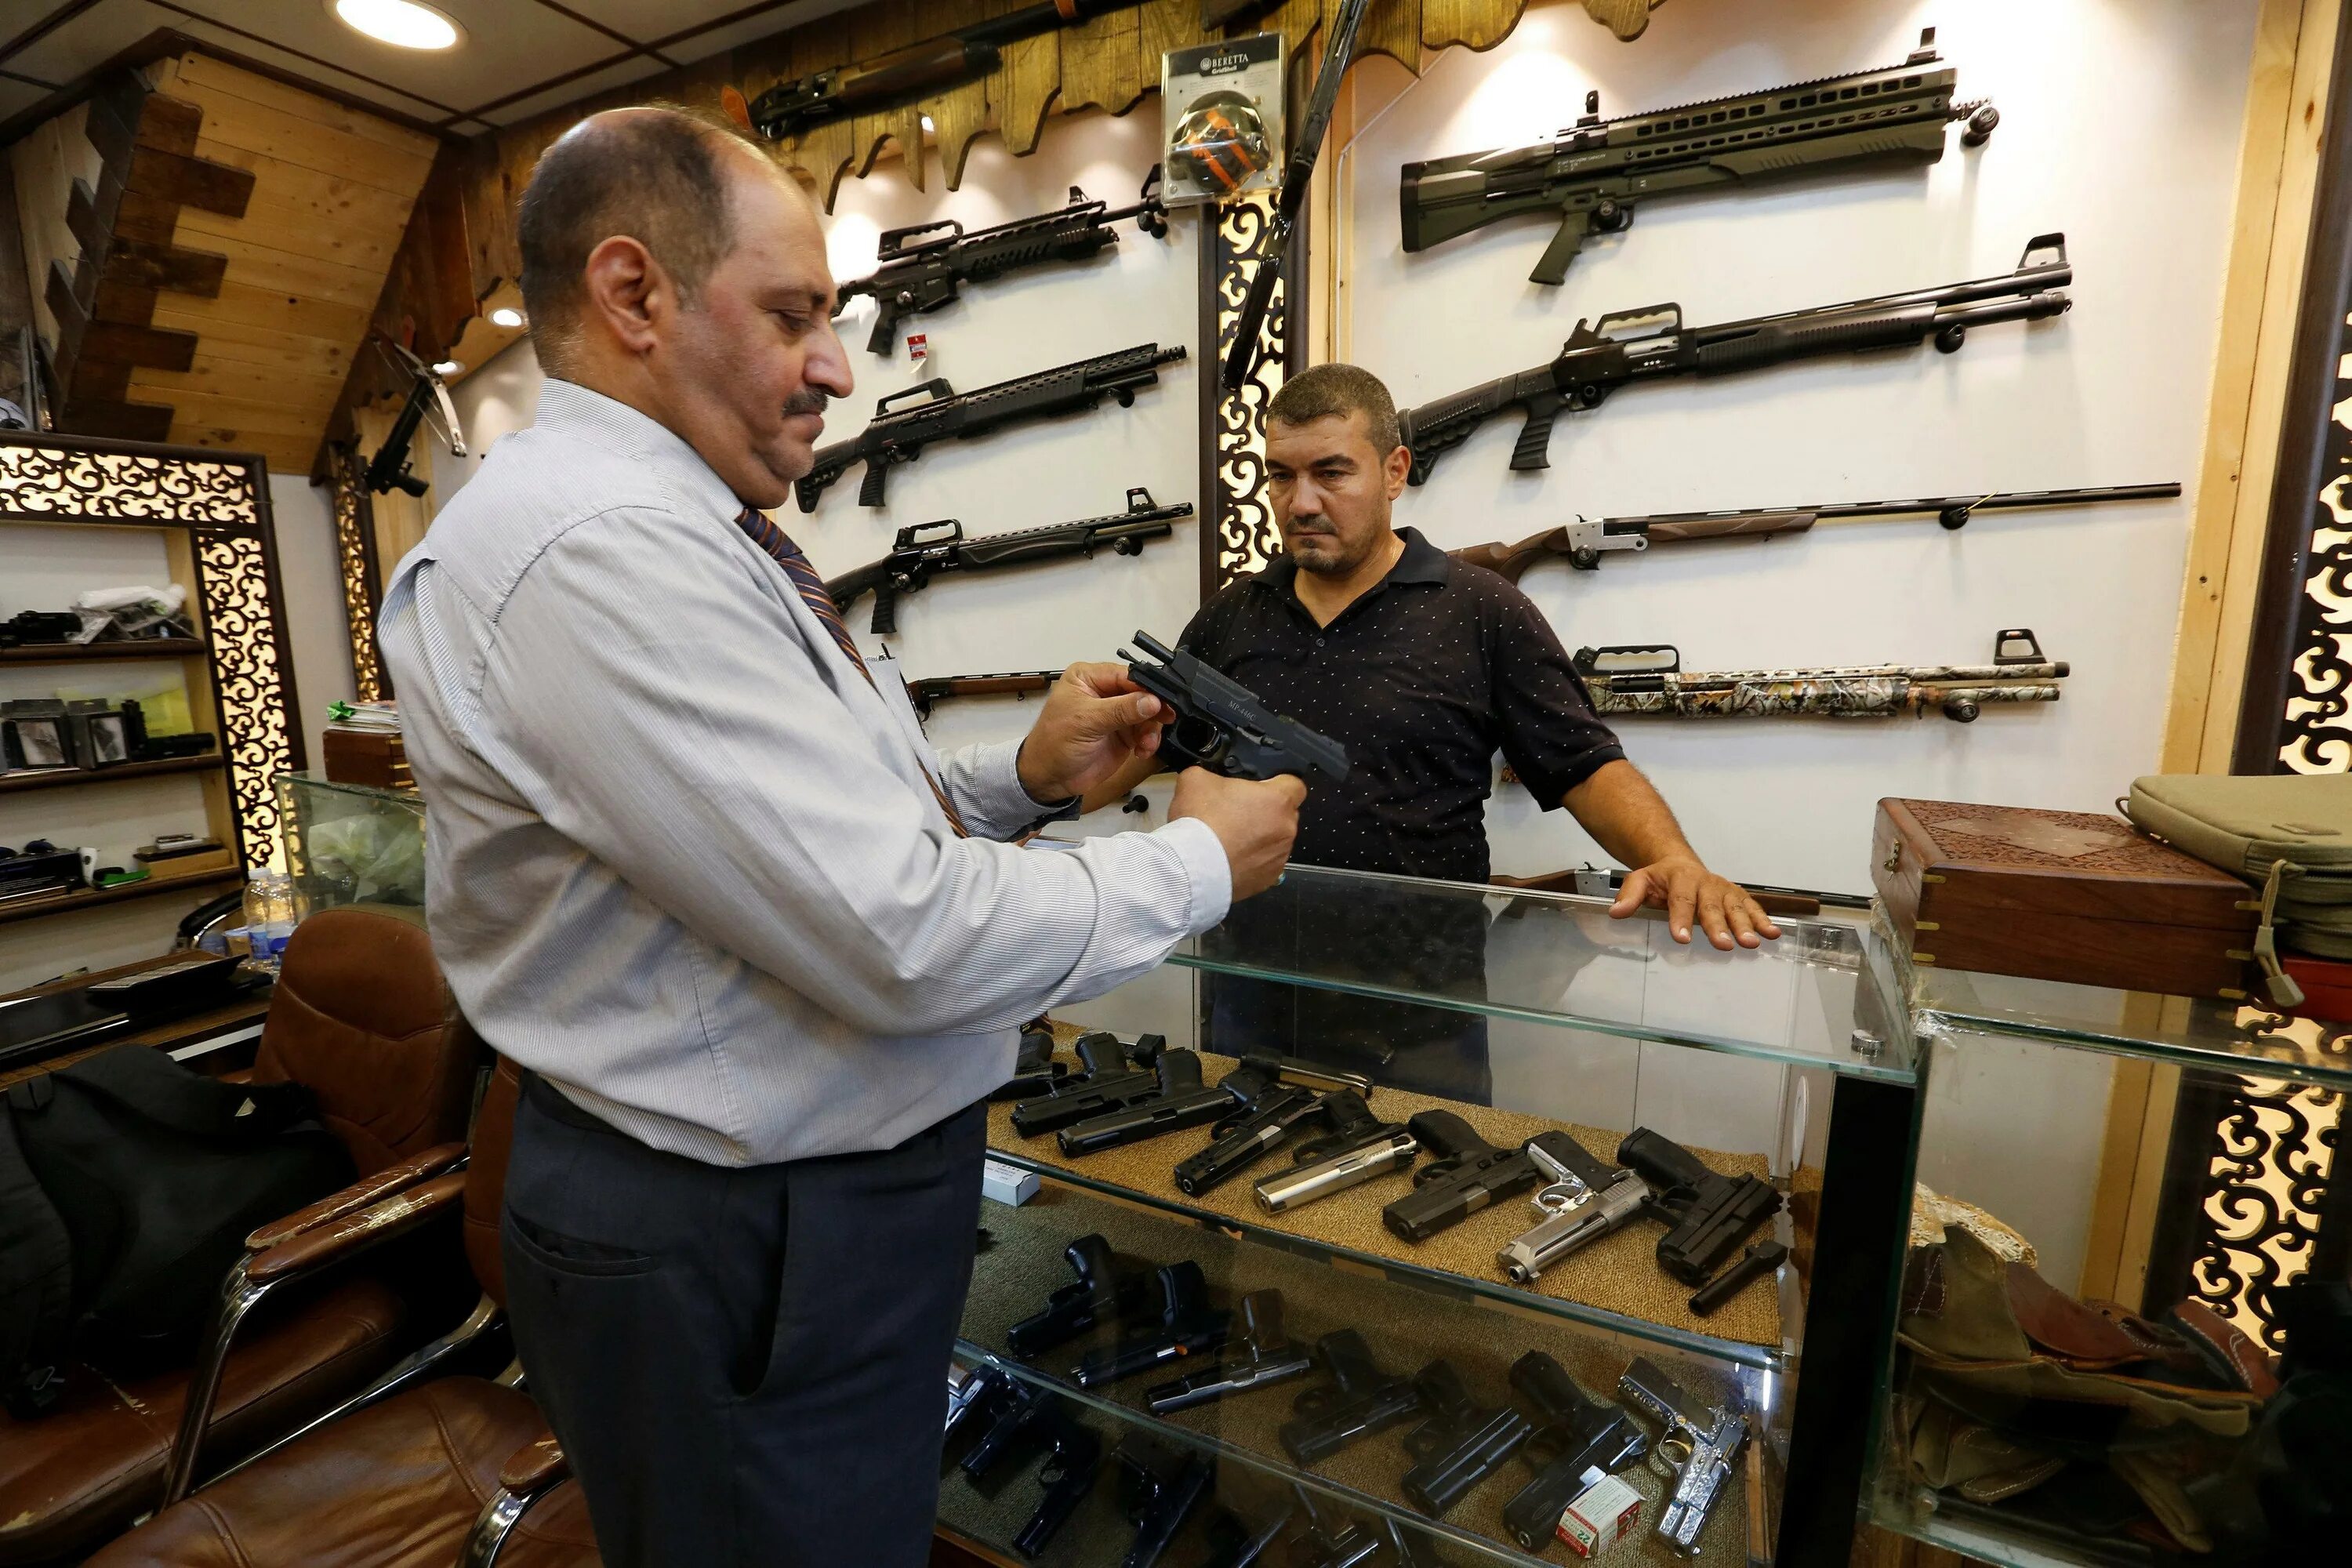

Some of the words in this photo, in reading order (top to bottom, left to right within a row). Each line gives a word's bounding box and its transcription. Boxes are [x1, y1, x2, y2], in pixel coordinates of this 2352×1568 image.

[1212, 53, 1248, 67] BERETTA
[1228, 700, 1256, 720] MP-446C
[1577, 1530, 1590, 1544] 22
